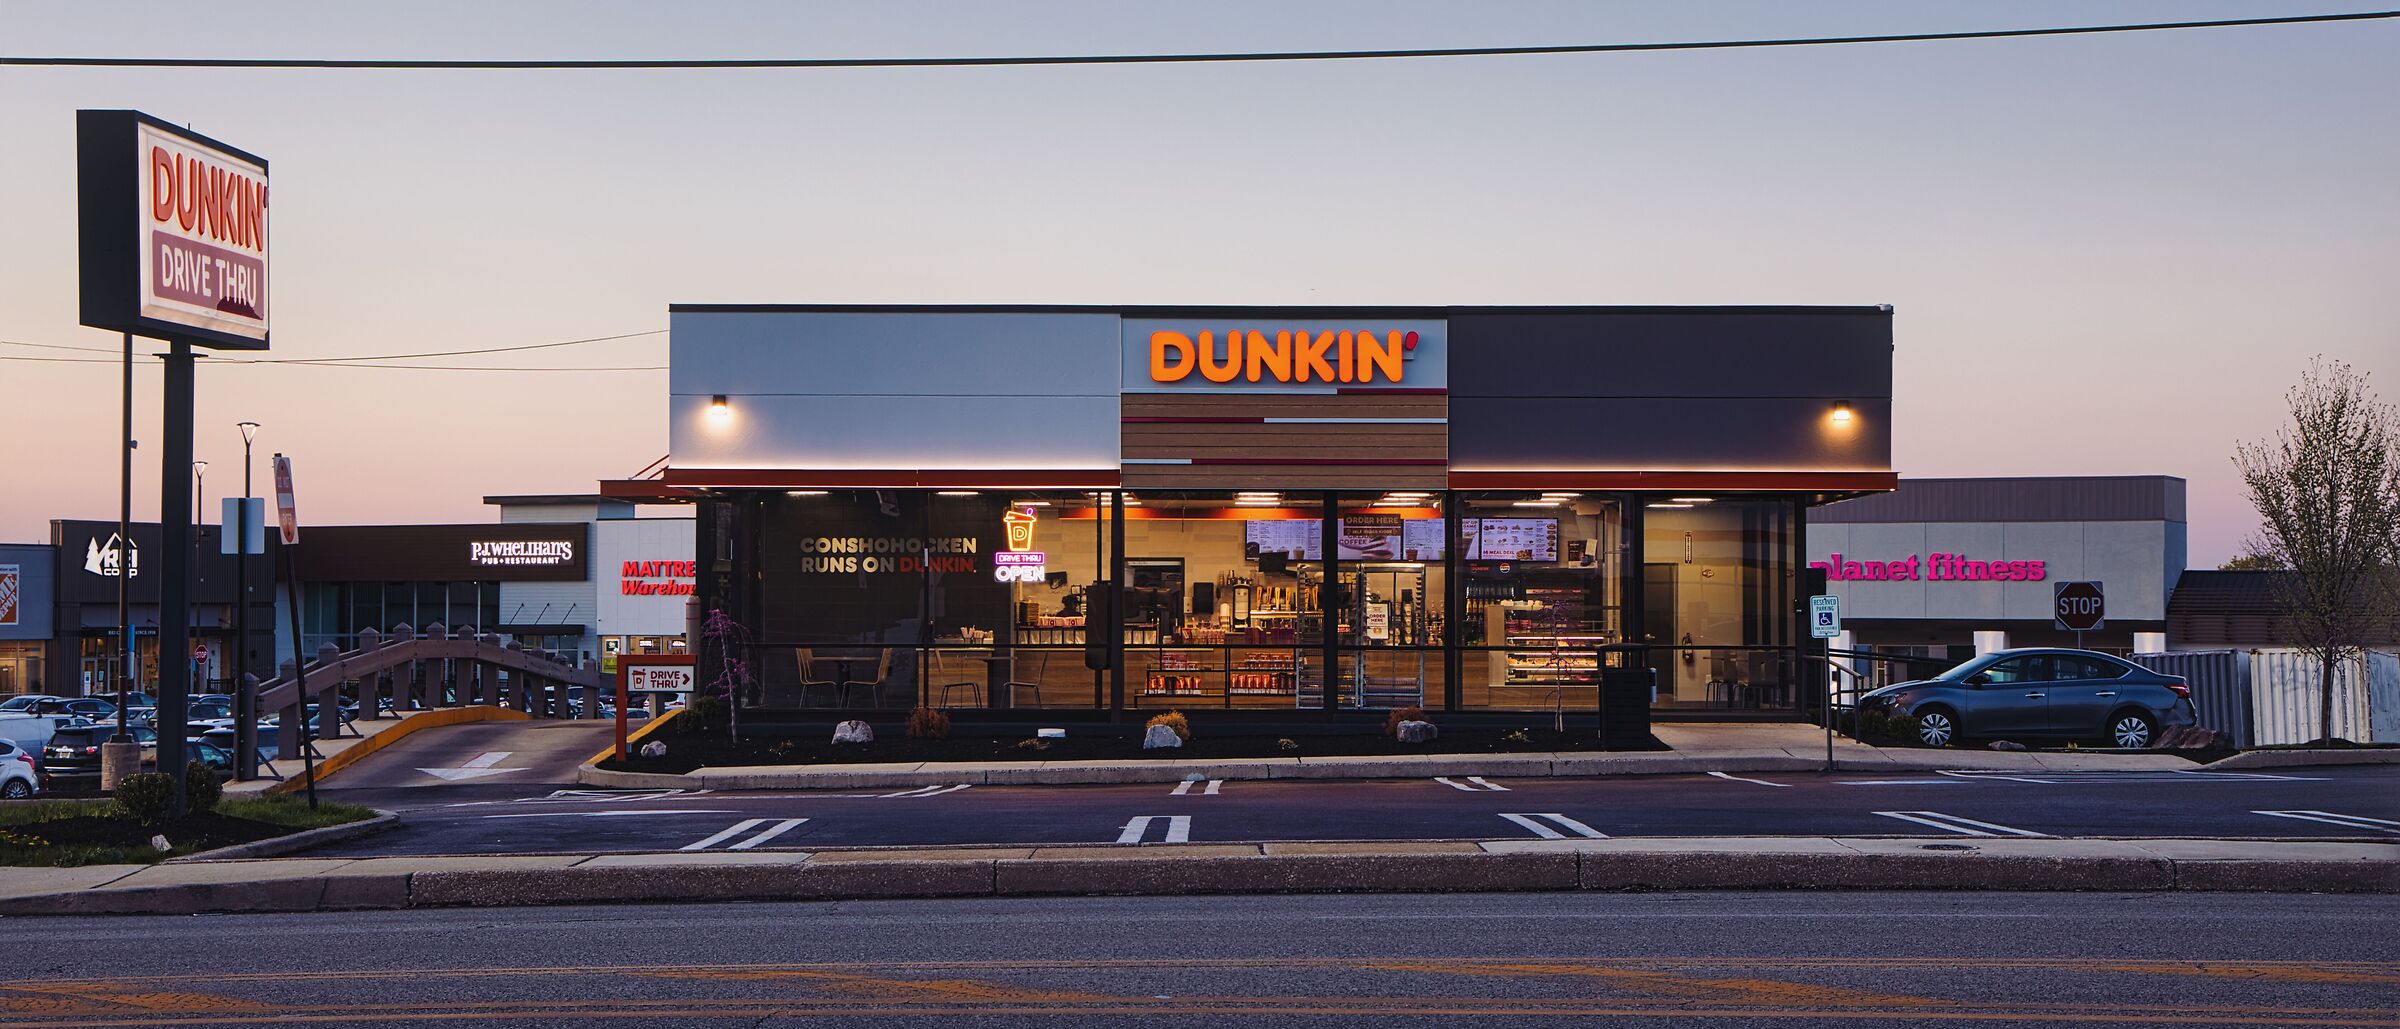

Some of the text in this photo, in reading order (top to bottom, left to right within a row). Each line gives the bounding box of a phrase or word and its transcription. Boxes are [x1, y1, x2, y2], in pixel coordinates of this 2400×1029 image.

[152, 146, 269, 252] DUNKIN'
[161, 244, 257, 308] DRIVE THRU
[1150, 329, 1420, 383] DUNKIN'
[1345, 516, 1399, 524] ORDER HERE
[800, 537, 977, 554] CONSHOHOCKEN
[104, 549, 138, 568] RI
[802, 556, 857, 573] RUNS
[863, 556, 894, 573] ON
[998, 554, 1042, 563] DRIVE THRU
[1927, 552, 2046, 581] fitness
[996, 565, 1045, 582] OPEN
[2059, 597, 2101, 615] STOP
[196, 651, 208, 659] STOP
[650, 671, 680, 680] DRIVE
[650, 680, 678, 688] THRU
